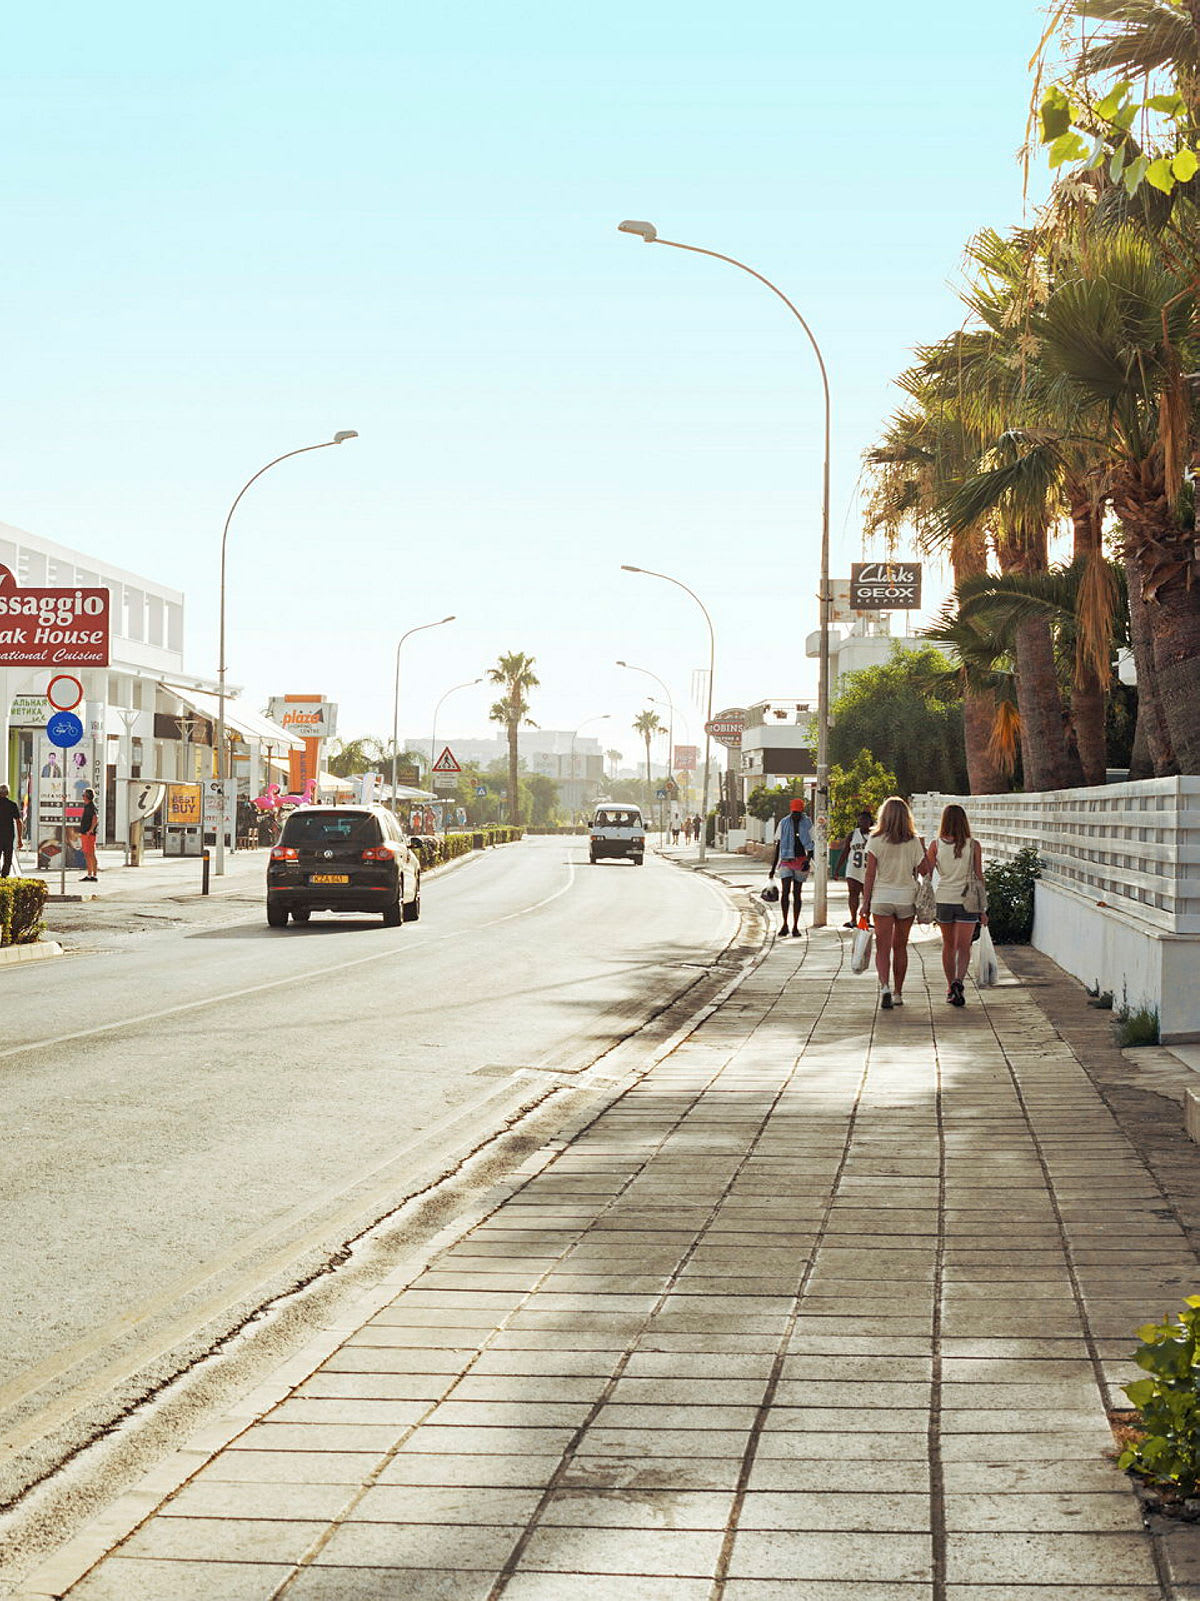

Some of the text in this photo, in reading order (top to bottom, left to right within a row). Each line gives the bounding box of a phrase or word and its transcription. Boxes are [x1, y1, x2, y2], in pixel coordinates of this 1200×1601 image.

[857, 588, 914, 598] GEOX
[33, 628, 103, 644] House
[52, 648, 103, 663] Cuisine
[282, 709, 321, 729] plaza
[172, 796, 196, 804] BEST
[172, 803, 196, 813] BUY
